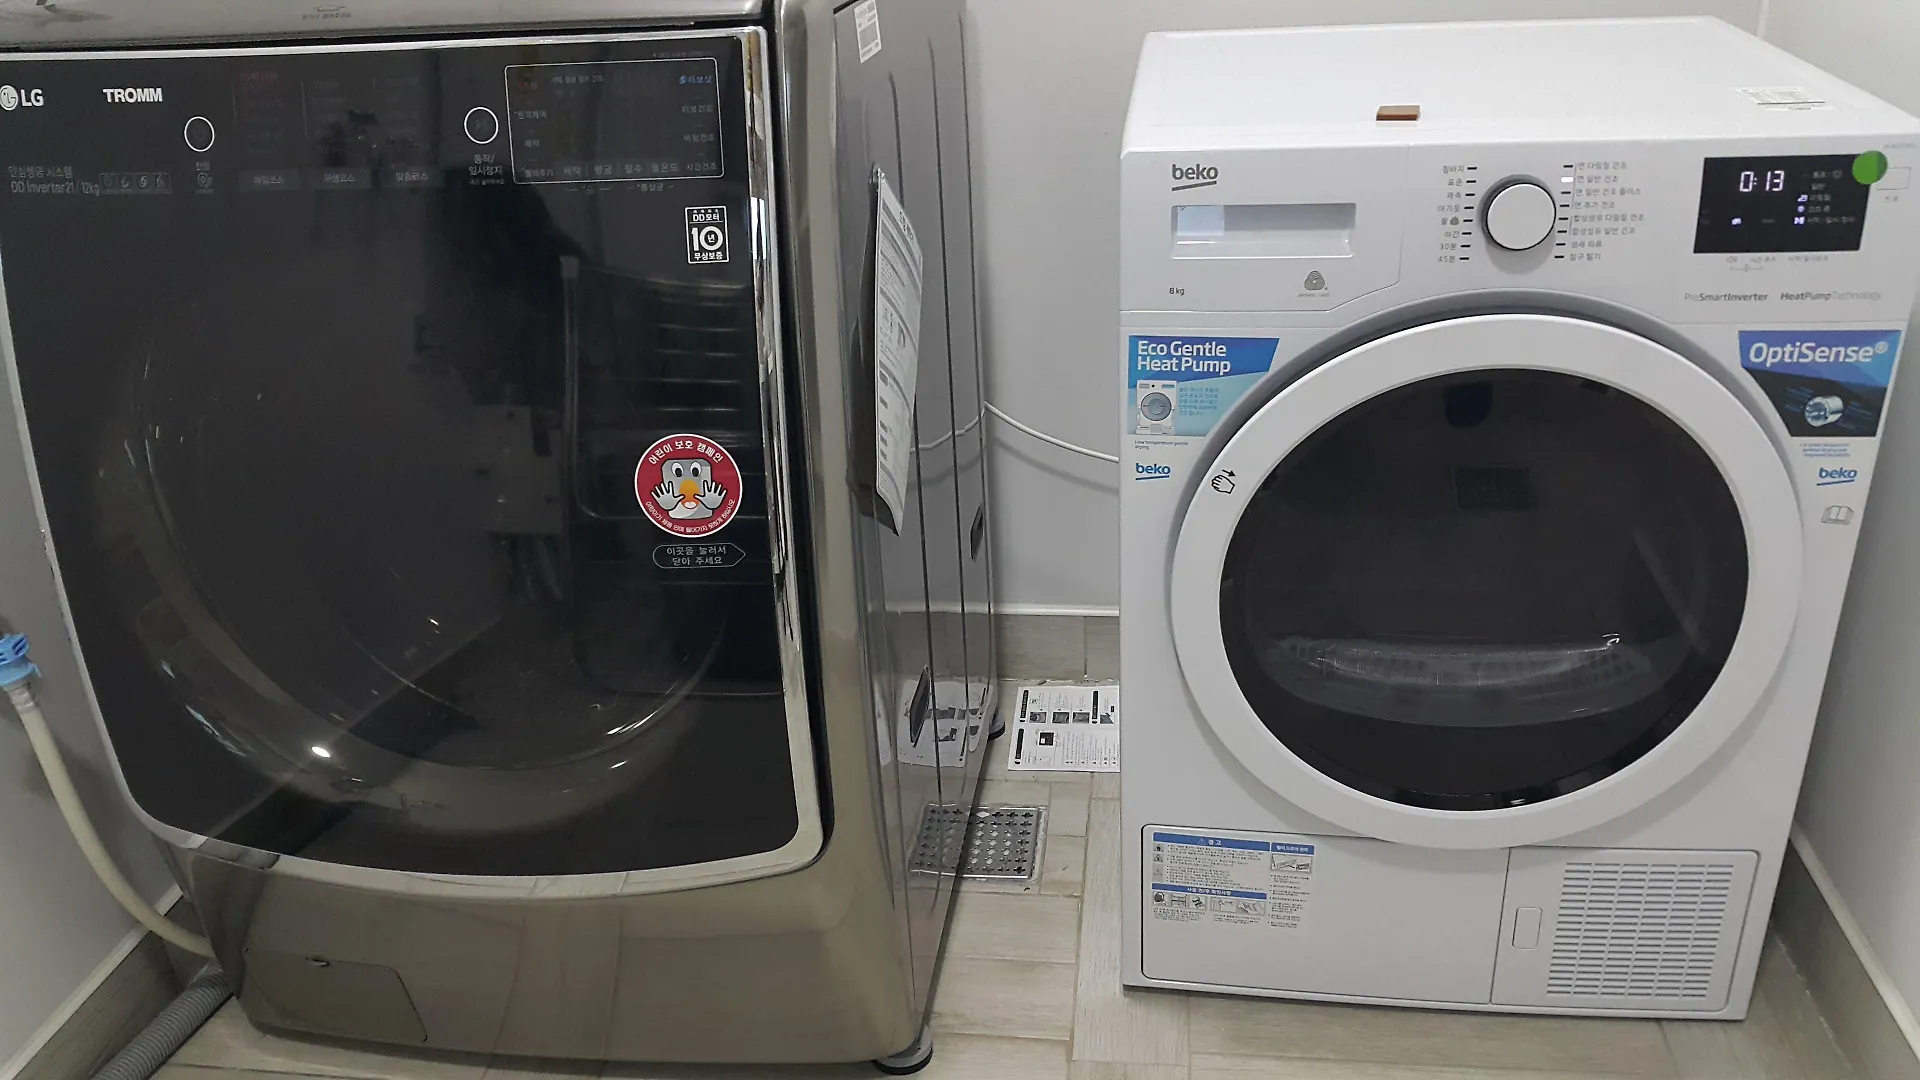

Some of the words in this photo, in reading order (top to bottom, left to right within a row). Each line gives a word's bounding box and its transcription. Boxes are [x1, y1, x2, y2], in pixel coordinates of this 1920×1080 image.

[20, 88, 44, 107] LG
[103, 87, 163, 103] TROMM
[468, 165, 503, 176] 일시정지
[1171, 163, 1219, 181] beko
[1739, 170, 1785, 192] 0:13
[692, 213, 720, 222] DD모터
[694, 251, 724, 260] 무상보증
[1437, 255, 1456, 263] 45분
[1137, 340, 1168, 356] Eco
[1170, 341, 1227, 357] Gentle
[1137, 356, 1179, 372] Heat
[1181, 357, 1231, 375] Pump
[648, 443, 674, 465] 어린이
[674, 440, 693, 450] 보호
[696, 442, 724, 463] 캠페인
[1135, 463, 1171, 475] beko
[1818, 467, 1857, 479] beko
[666, 546, 694, 556] 이곳을
[698, 545, 727, 555] 눌러서
[672, 556, 691, 567] 닫아
[695, 556, 723, 566] 주세요
